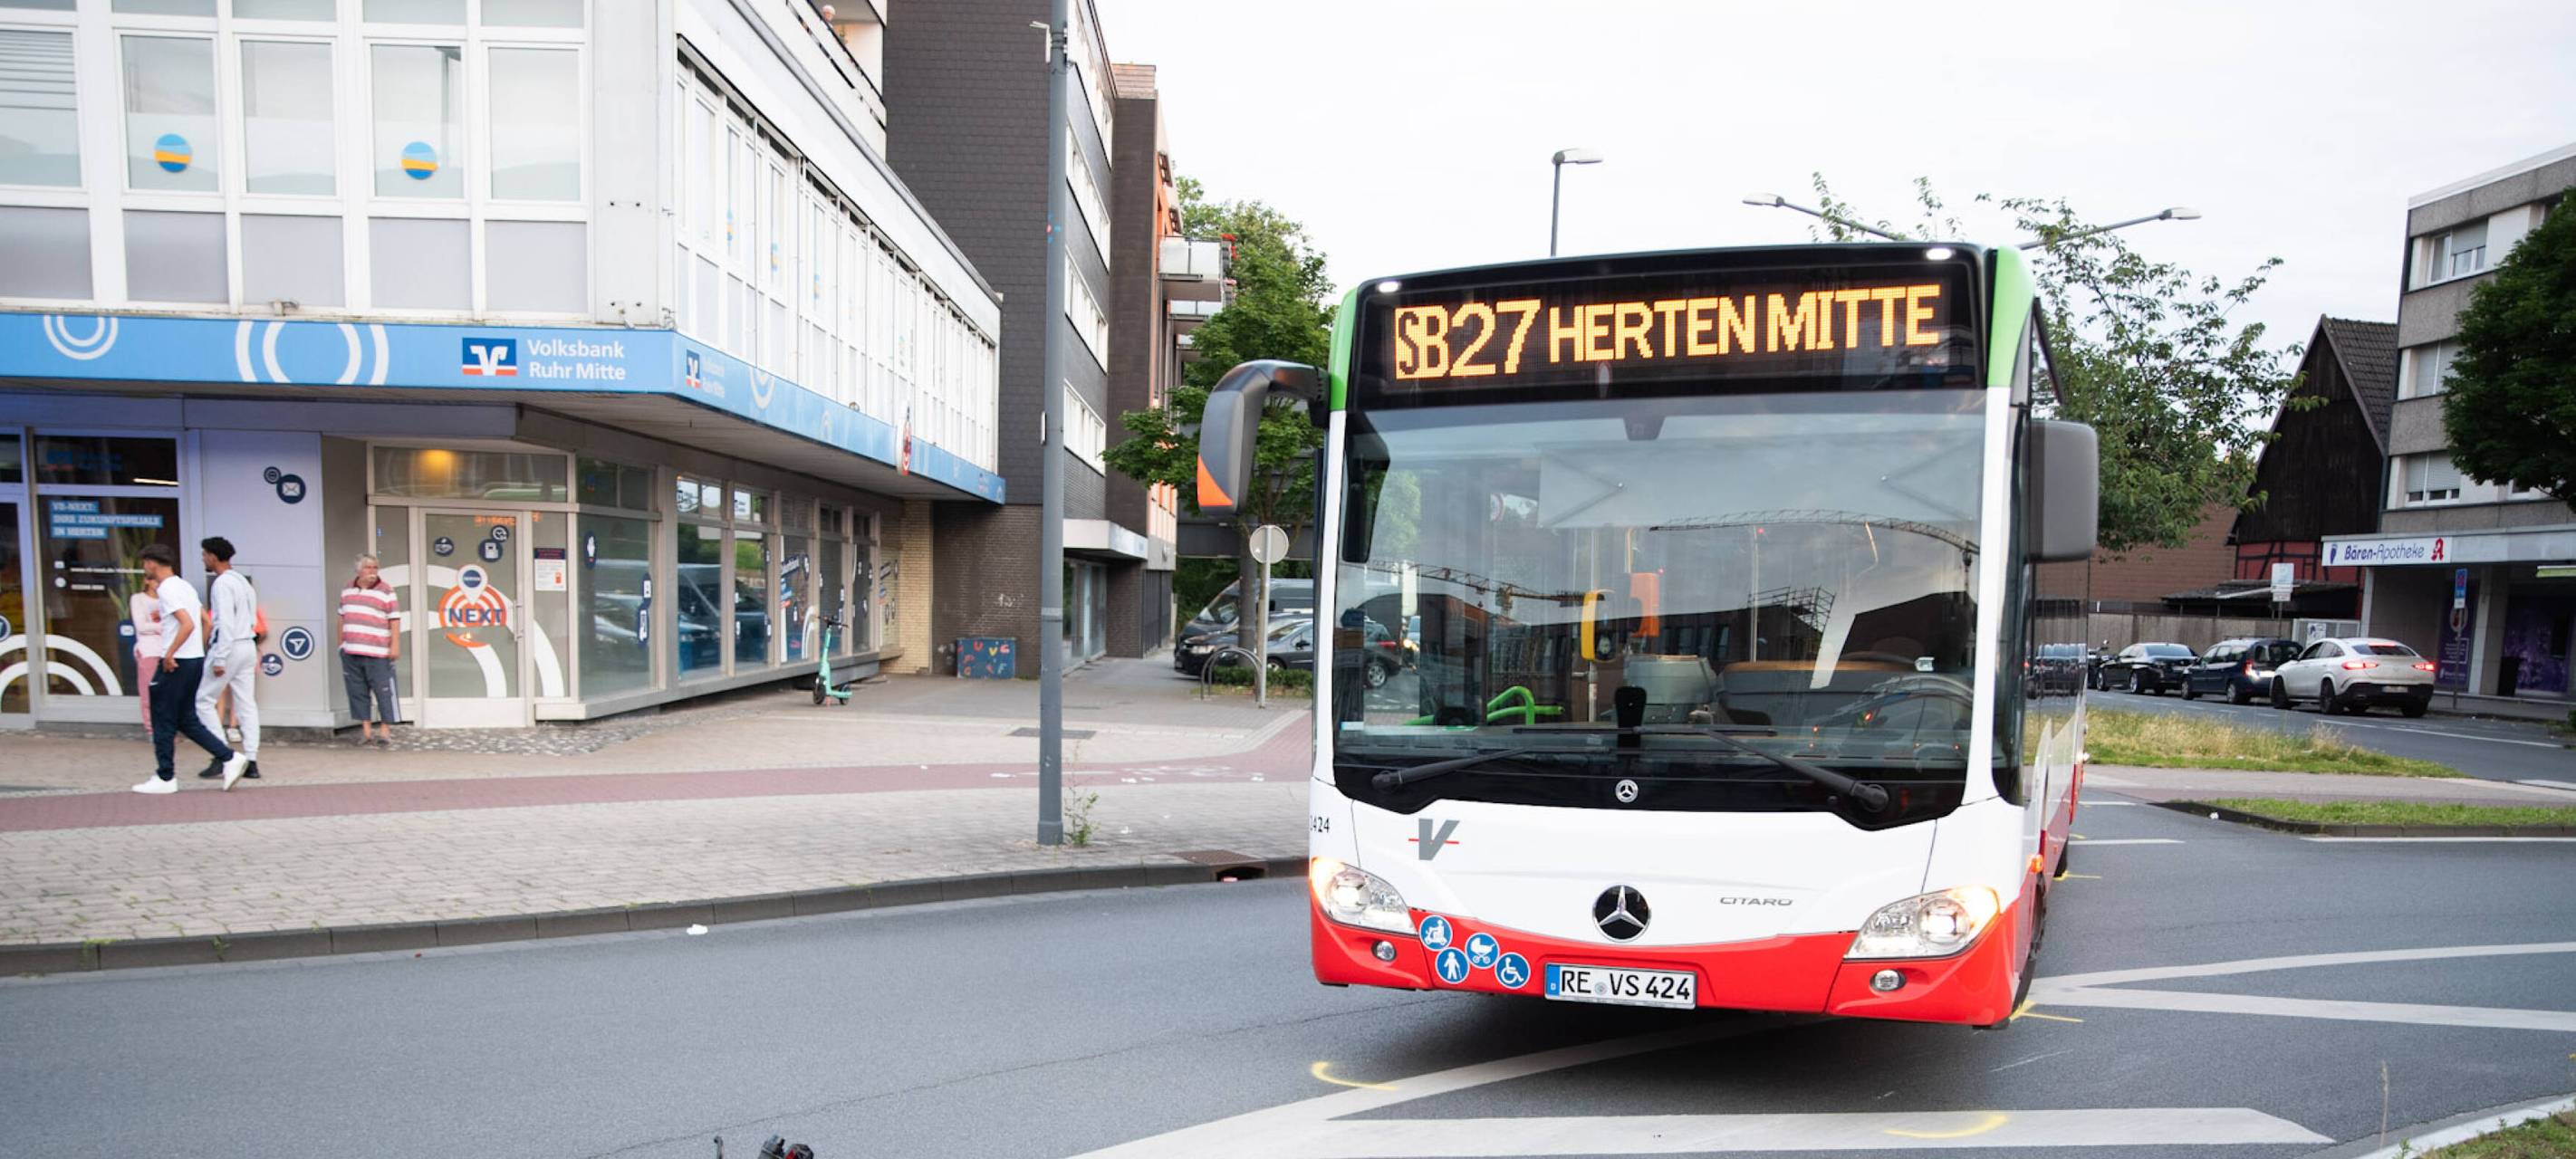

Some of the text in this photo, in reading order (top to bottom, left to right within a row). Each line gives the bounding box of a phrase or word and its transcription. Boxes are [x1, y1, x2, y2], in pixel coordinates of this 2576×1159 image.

[1395, 284, 1941, 380] SB27 HERTEN MITTE
[528, 339, 625, 359] Volksbank
[529, 361, 627, 380] Ruhr Mitte
[2344, 543, 2425, 563] Bären-Apotheke
[447, 608, 504, 624] NEXT
[1720, 896, 1793, 906] CITARO
[1562, 970, 1690, 1001] RE VS 424
